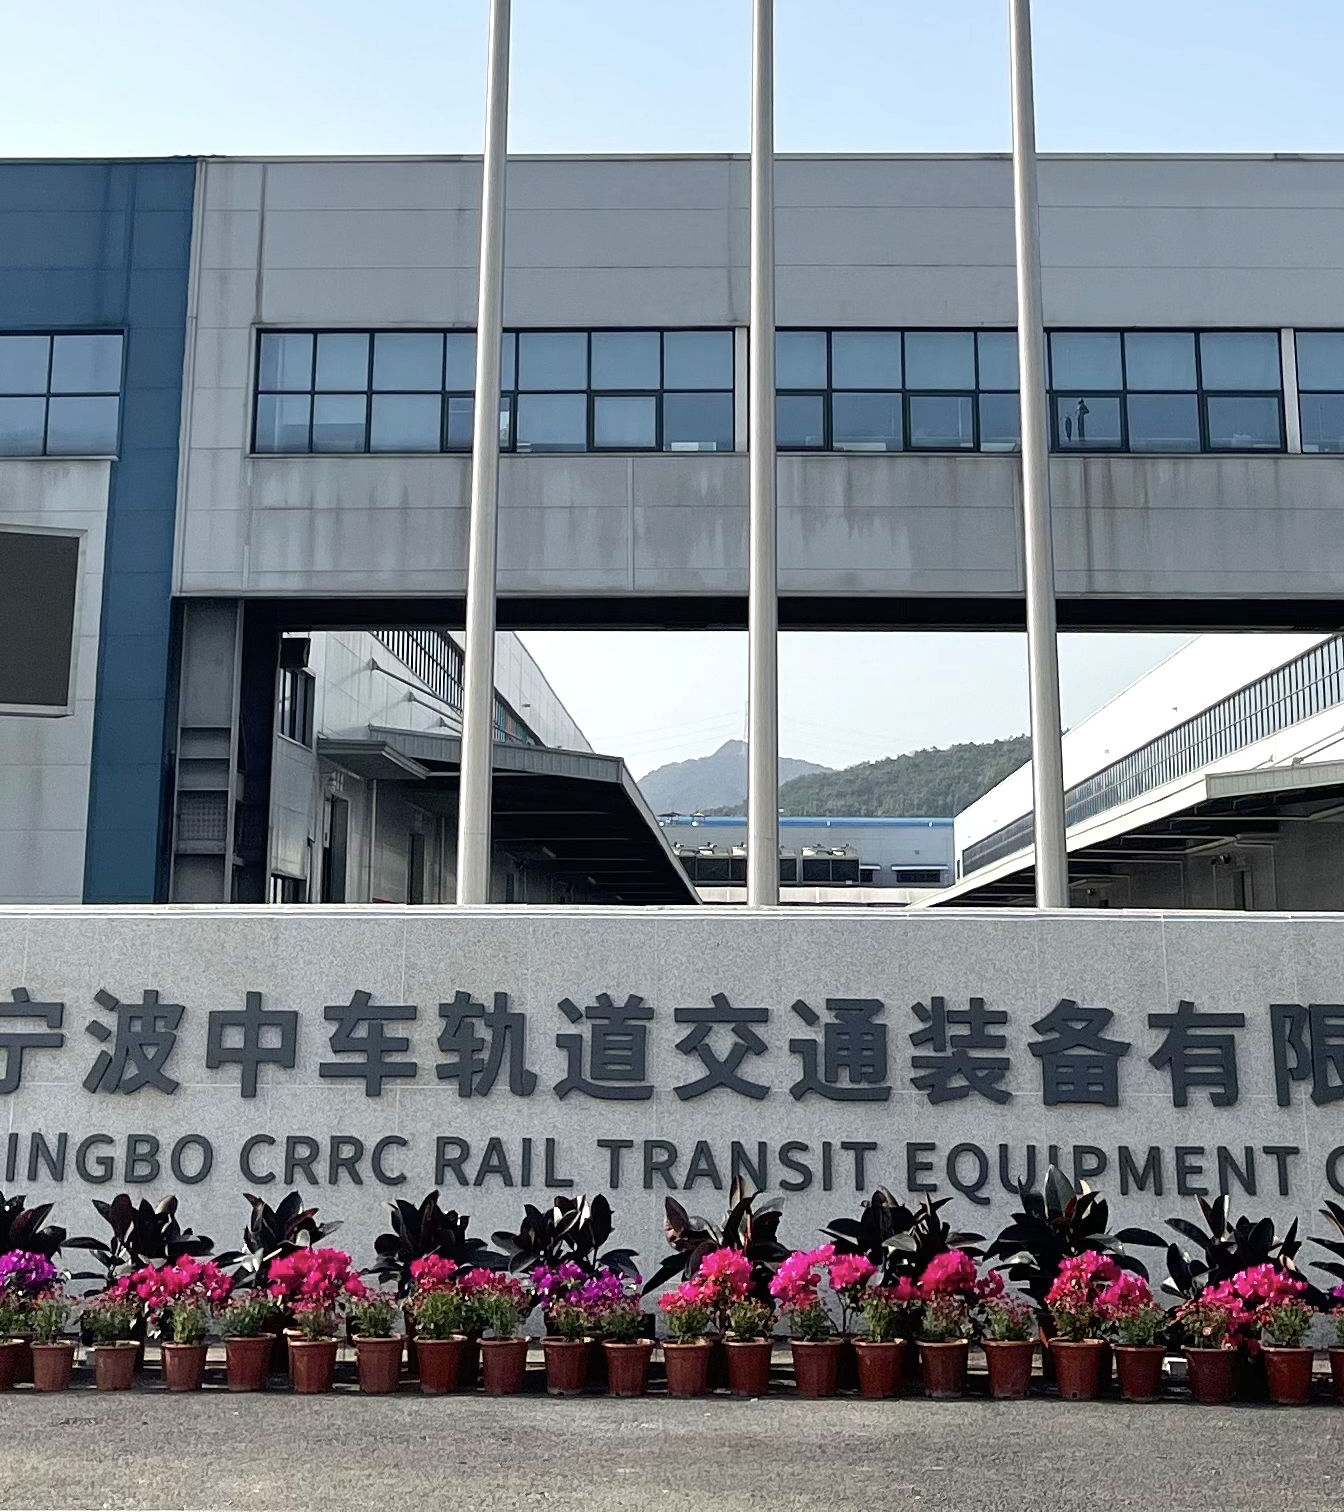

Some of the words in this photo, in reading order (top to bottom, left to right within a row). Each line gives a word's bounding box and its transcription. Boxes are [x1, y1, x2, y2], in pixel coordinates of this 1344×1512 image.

[239, 1133, 409, 1187] CRRC
[434, 1135, 574, 1189] RAIL
[597, 1138, 878, 1192] TRANSIT
